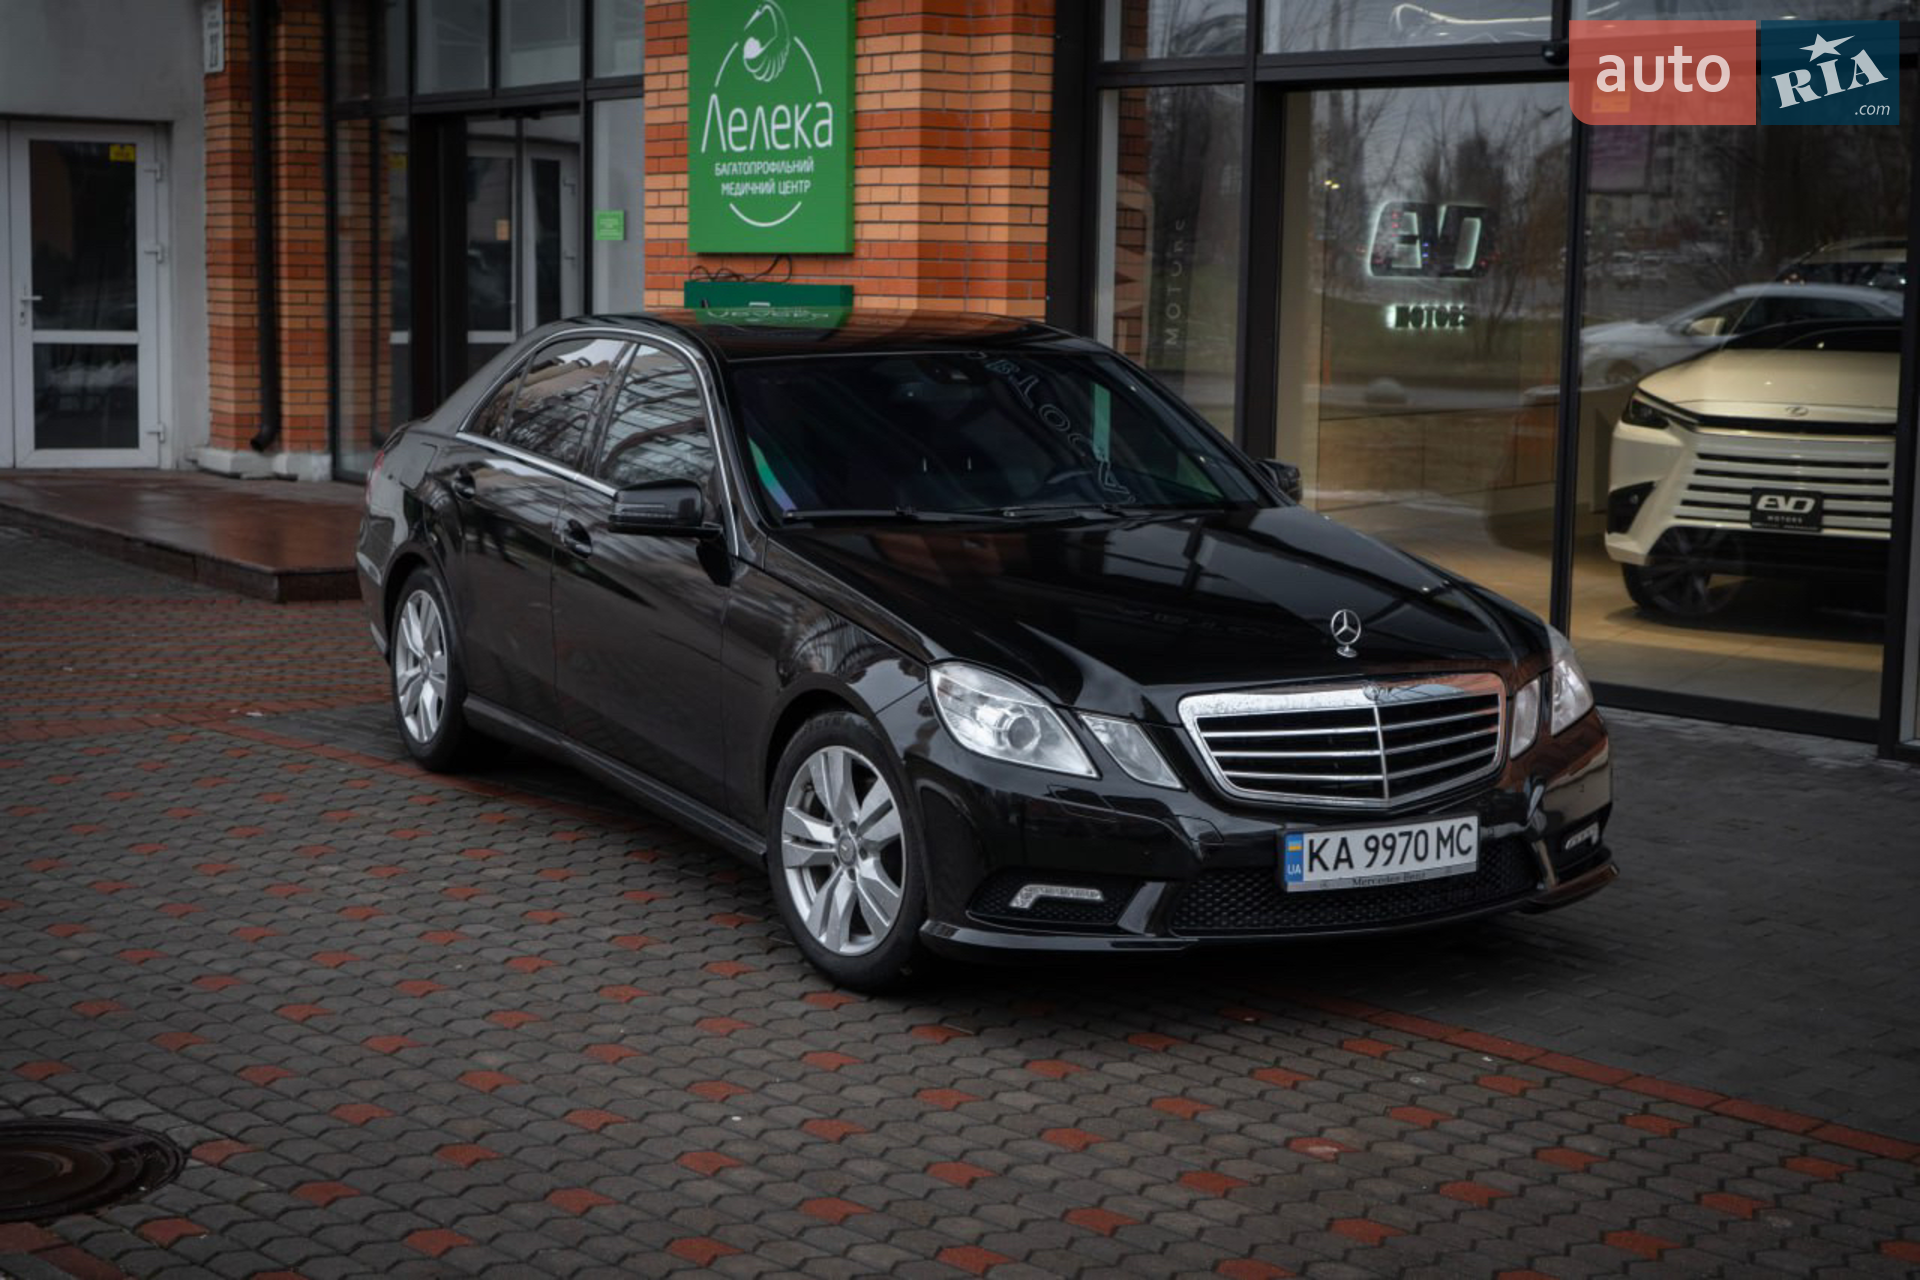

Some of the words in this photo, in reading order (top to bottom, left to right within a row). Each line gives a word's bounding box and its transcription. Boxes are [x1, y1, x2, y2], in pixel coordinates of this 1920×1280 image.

[701, 93, 834, 153] Лелека
[715, 156, 814, 176] БАГАТОПРОФІЛЬНИЙ
[721, 178, 776, 196] МЕДИЧНИЙ
[778, 180, 811, 195] ЦЕНТР
[1756, 494, 1816, 514] EVO
[1308, 837, 1354, 873] KA
[1364, 829, 1429, 868] 9970
[1436, 823, 1473, 860] MC
[1287, 863, 1302, 875] UA
